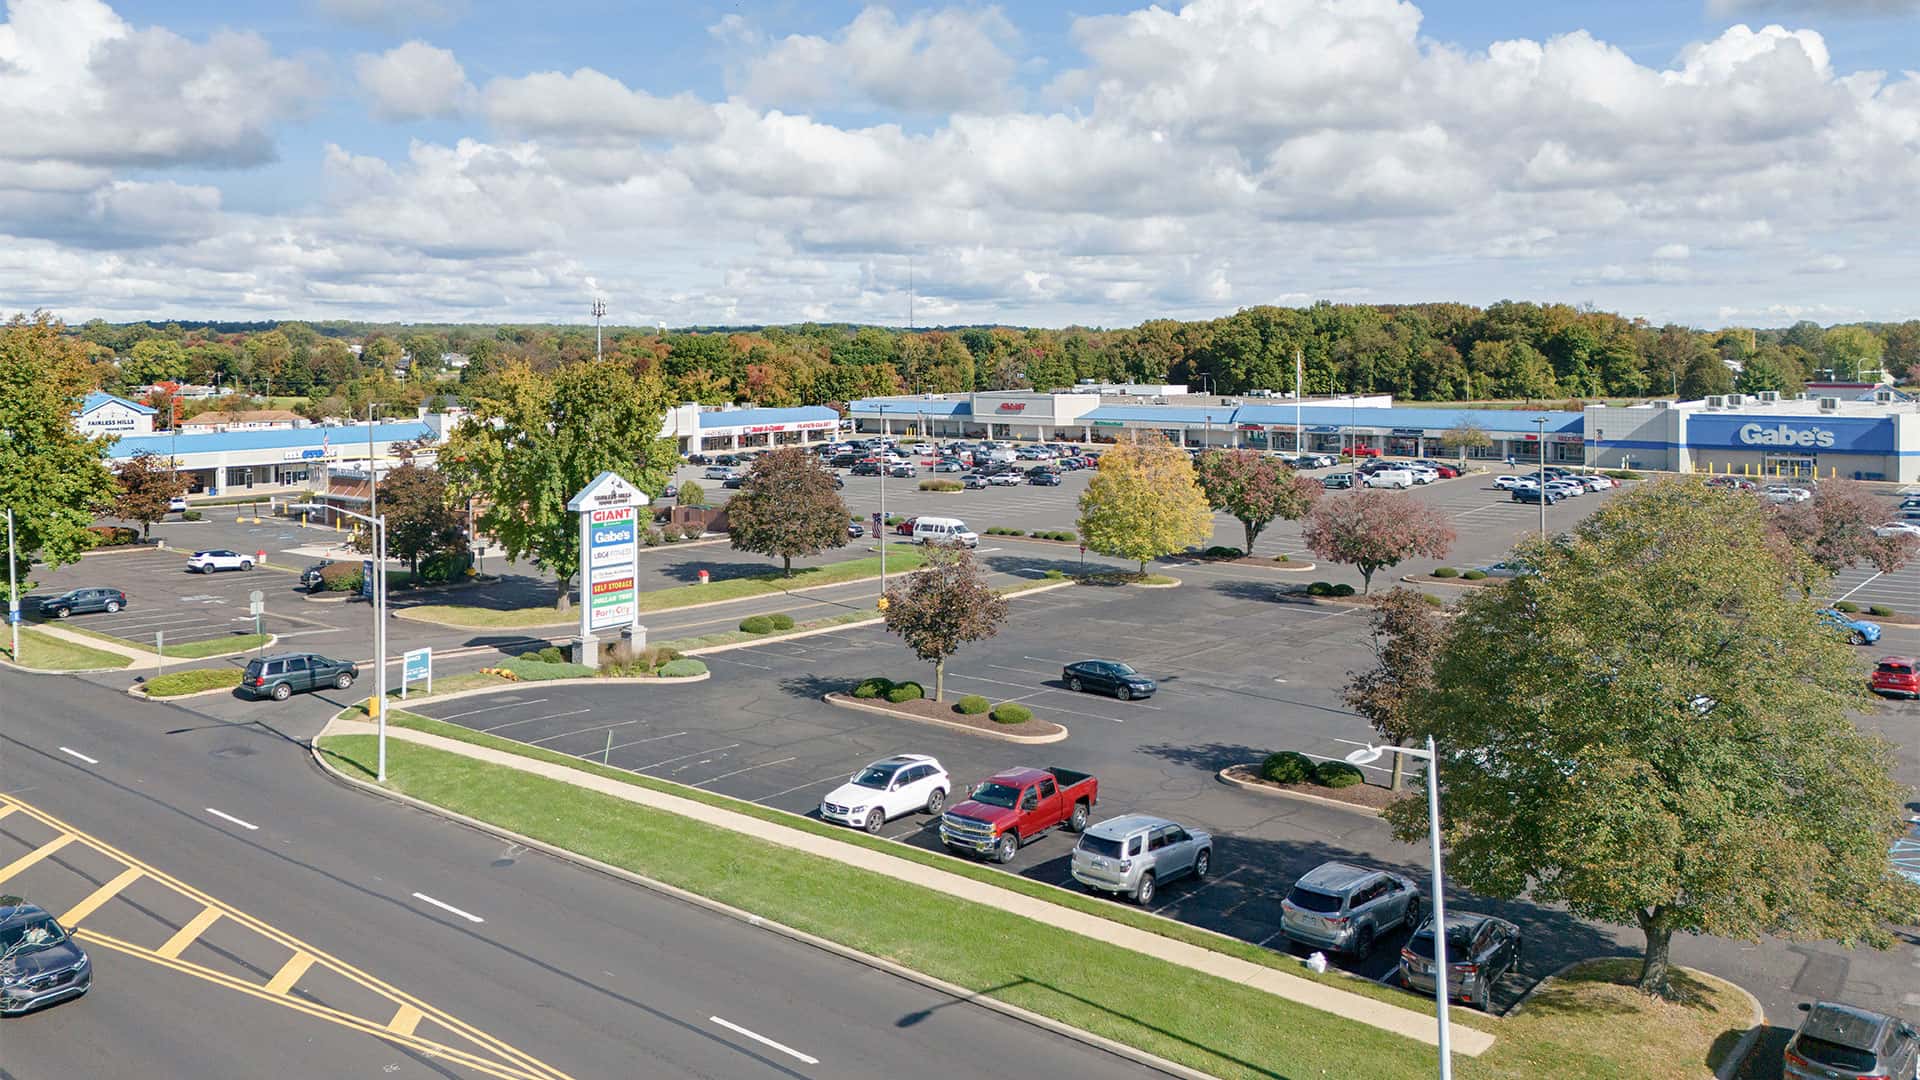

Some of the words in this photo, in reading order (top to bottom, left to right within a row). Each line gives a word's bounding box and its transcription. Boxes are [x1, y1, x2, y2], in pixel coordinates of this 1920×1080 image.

[1739, 423, 1834, 447] Gabe's
[593, 509, 631, 522] GIANT
[595, 529, 631, 544] Gabe's
[594, 583, 607, 593] SELF
[608, 579, 633, 590] STORAGE
